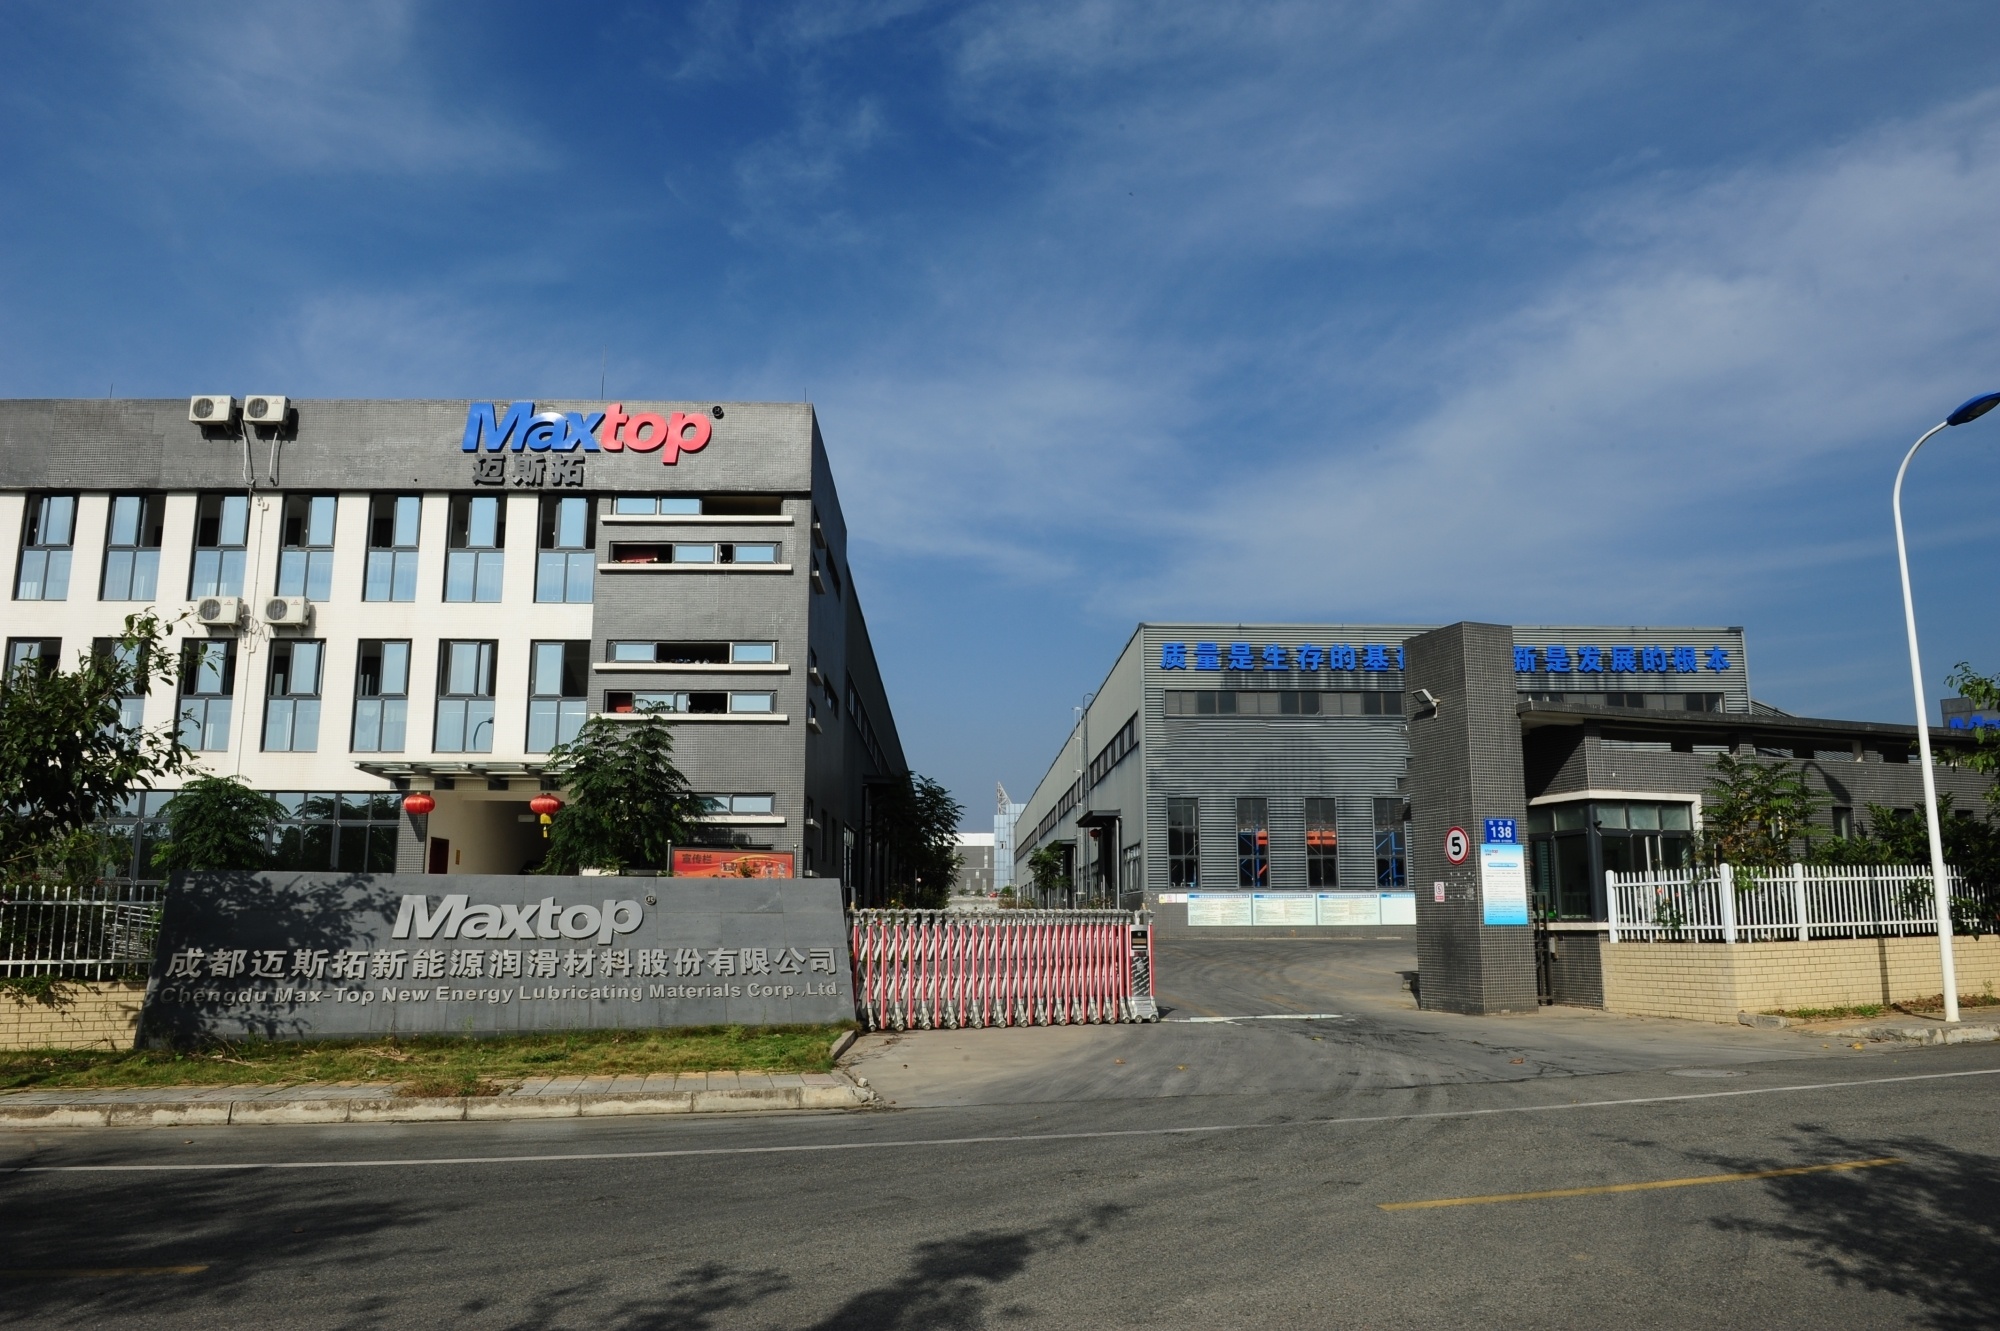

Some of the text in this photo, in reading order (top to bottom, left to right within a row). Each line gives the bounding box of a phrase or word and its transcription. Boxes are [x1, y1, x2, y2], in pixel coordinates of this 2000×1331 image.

[462, 402, 711, 464] Maxtop
[472, 454, 586, 486] 迈斯拓
[1451, 836, 1462, 855] 5
[1490, 826, 1512, 838] 138
[682, 853, 712, 864] 宣传栏
[391, 894, 644, 945] Maxtop
[165, 947, 837, 980] 成都迈斯拓新能源润滑材料股份有限公司
[160, 986, 267, 1006] Chengdu
[274, 986, 375, 1006] Max-Top
[381, 986, 430, 1002] New
[435, 985, 514, 1005] Energy
[518, 984, 643, 1003] Lubricating
[649, 983, 742, 999] Materials
